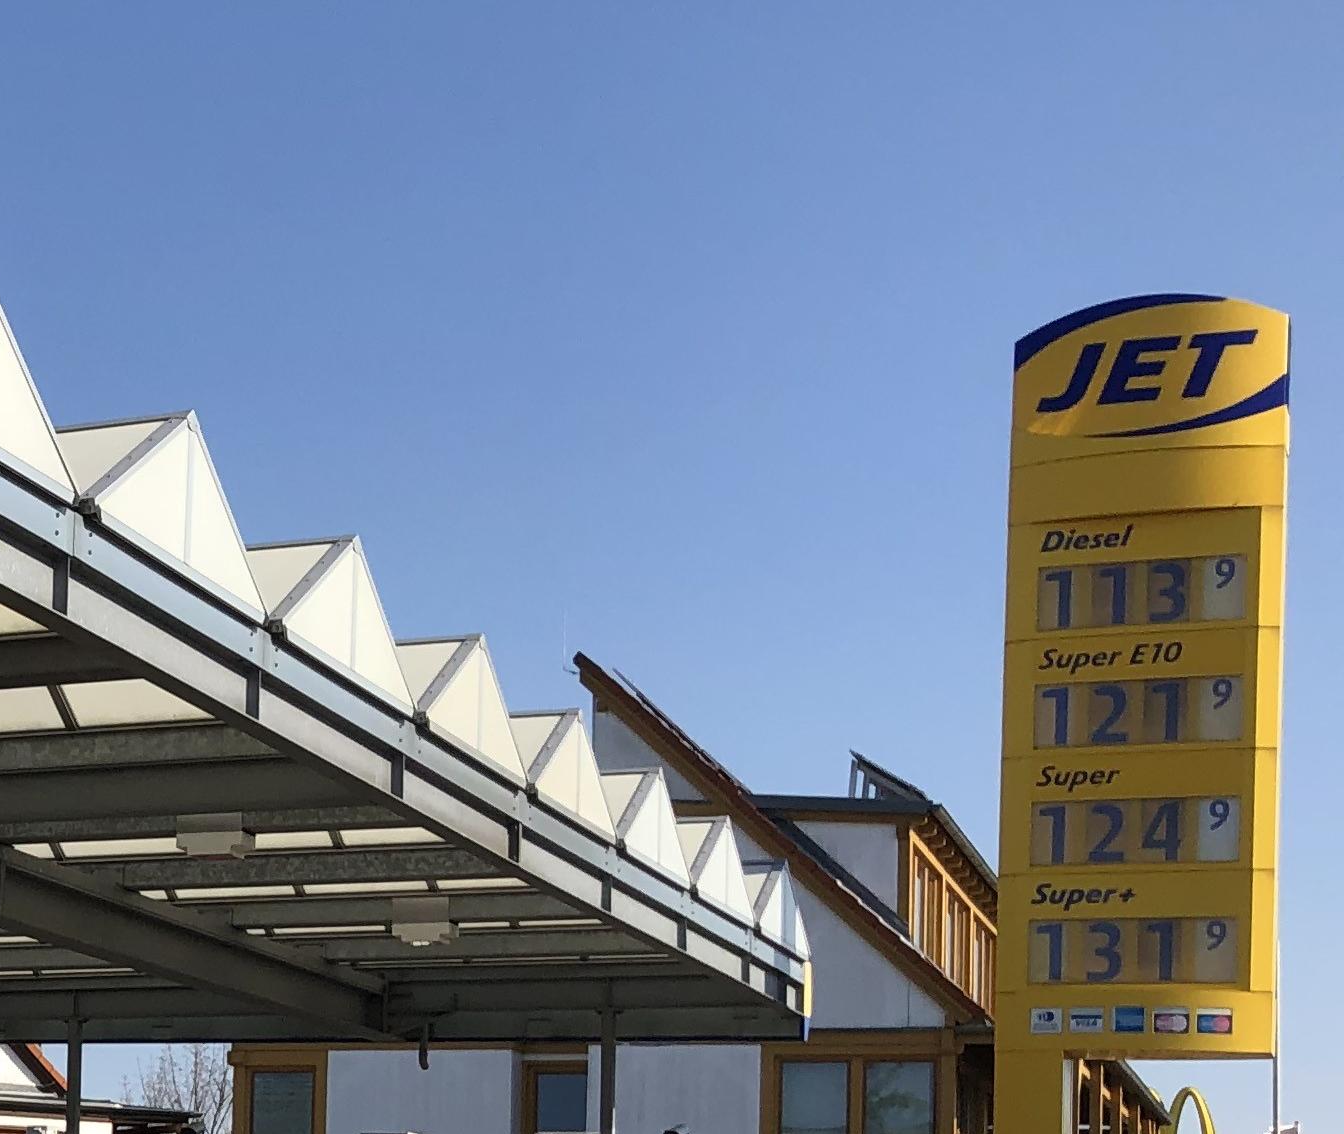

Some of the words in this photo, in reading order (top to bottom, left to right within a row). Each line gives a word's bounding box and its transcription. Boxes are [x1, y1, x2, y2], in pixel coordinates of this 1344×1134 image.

[1035, 329, 1259, 413] JET
[1040, 524, 1134, 553] Diesel
[1038, 648, 1123, 675] Super
[1129, 642, 1182, 666] E10
[1036, 765, 1120, 793] Super
[1030, 882, 1136, 911] Super+
